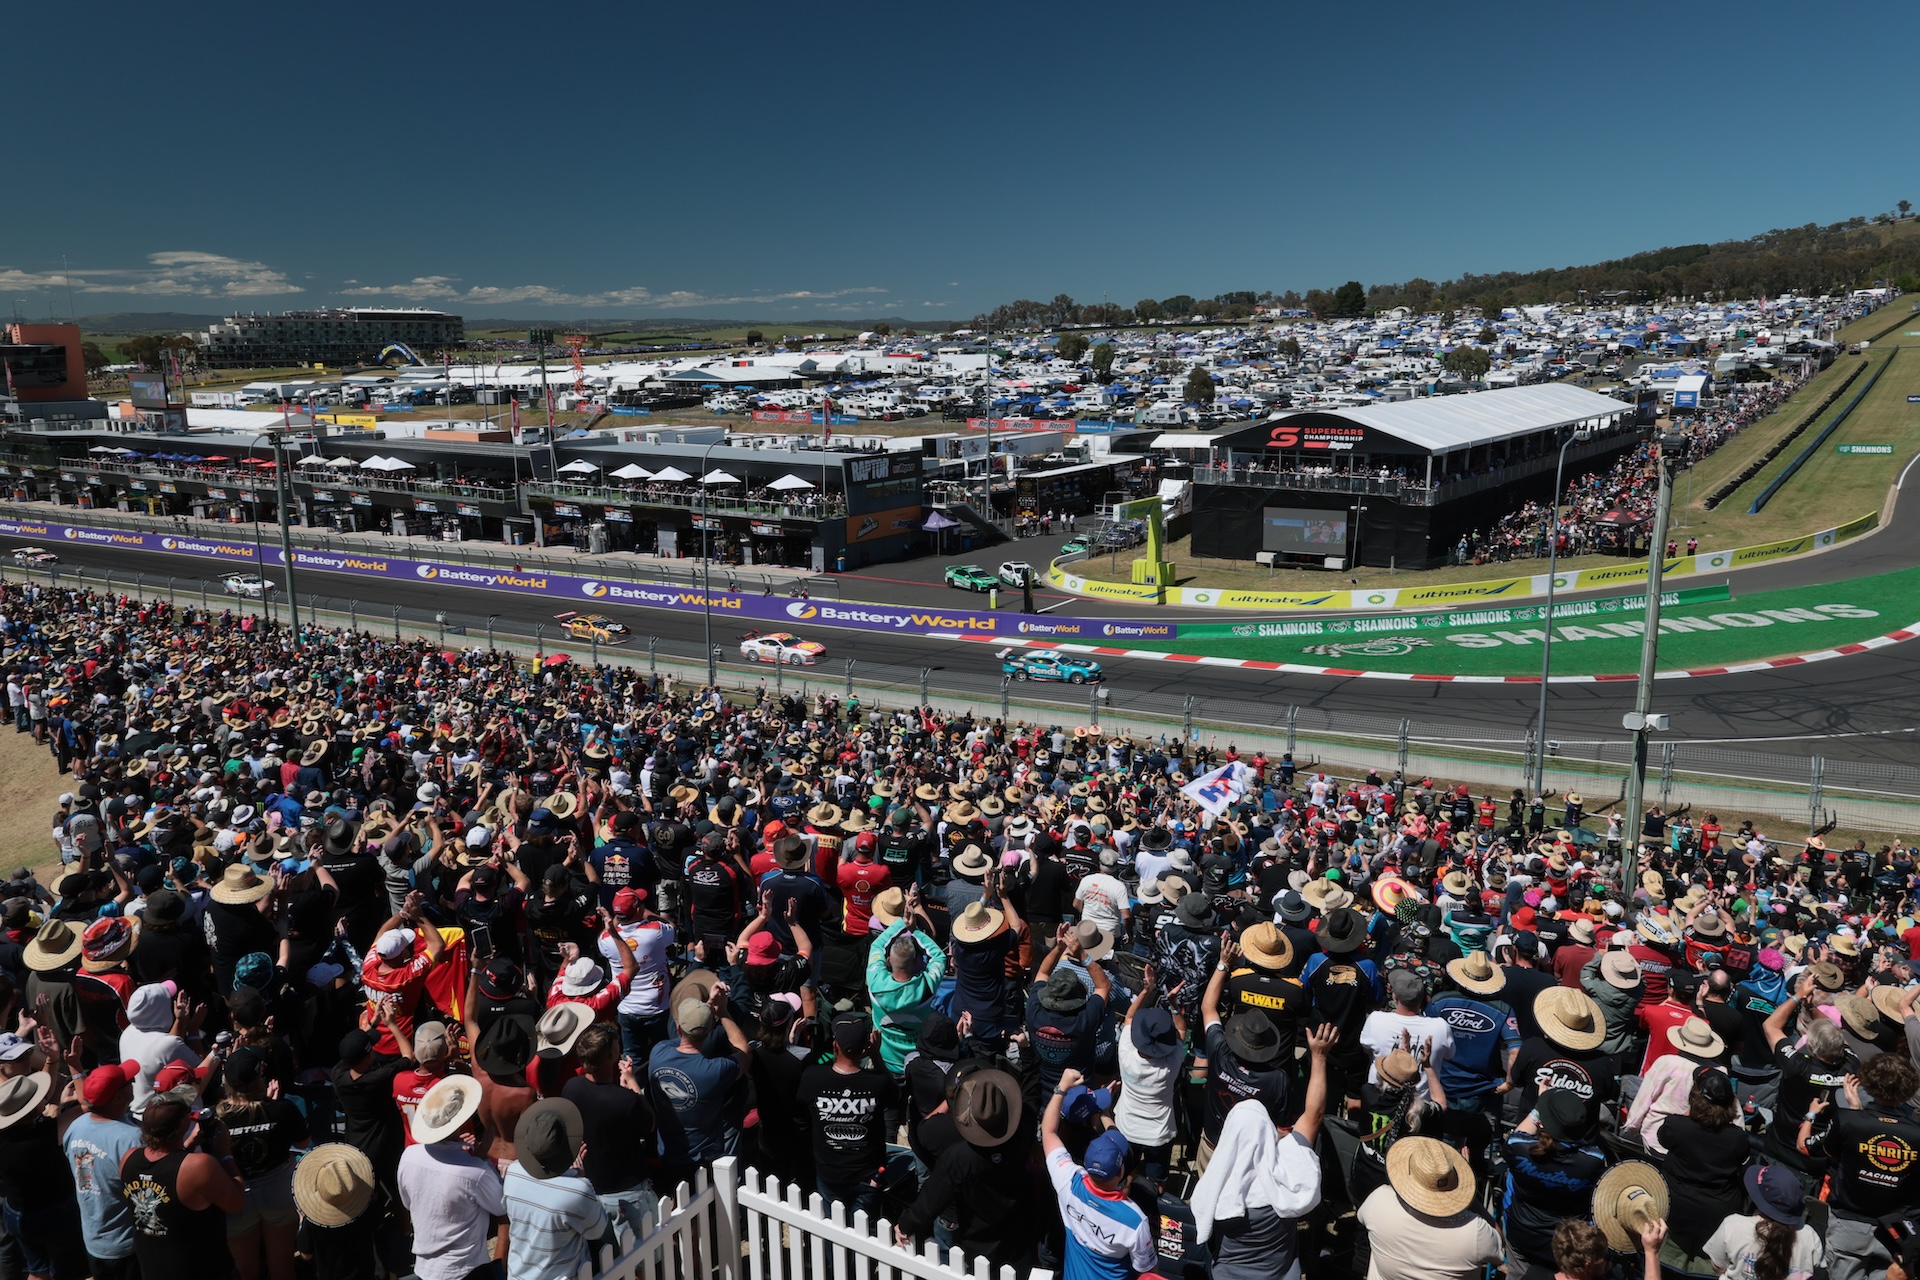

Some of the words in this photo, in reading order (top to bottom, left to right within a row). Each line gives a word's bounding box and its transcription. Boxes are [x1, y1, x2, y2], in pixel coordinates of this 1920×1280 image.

[1012, 421, 1034, 430] Repco
[1049, 421, 1071, 431] Repco
[1304, 427, 1364, 436] SUPERCARS
[1328, 440, 1354, 450] Repco
[1851, 445, 1892, 454] SHANNONS
[850, 457, 889, 482] RAPTOR
[78, 530, 144, 546] BatteryWorld
[177, 541, 254, 558] BatteryWorld
[1738, 545, 1790, 560] ultimate
[297, 554, 388, 572] BatteryWorld
[439, 568, 547, 590] BatteryWorld
[609, 586, 742, 611] BatteryWorld
[1088, 585, 1143, 598] ultimate
[1230, 594, 1303, 605] ultimate
[1413, 586, 1488, 600] ultimate
[820, 607, 997, 631] BatteryWorld
[1353, 616, 1418, 633] SHANNONS
[1445, 603, 1880, 649] SHANNONS
[1448, 609, 1511, 627] SHANNONS
[1029, 622, 1081, 635] BatteryWorld
[1114, 623, 1168, 636] BatteryWorld
[1258, 622, 1323, 637] SHANNONS
[1028, 665, 1062, 677] Bendix
[1447, 1011, 1483, 1032] Ford
[1218, 1071, 1261, 1097] BATHURST
[1534, 1067, 1594, 1100] Eldora
[816, 1097, 876, 1115] DXXN
[819, 1111, 857, 1123] Flannel
[1859, 1142, 1918, 1162] PENRITE
[1859, 1169, 1899, 1182] RACING
[142, 1181, 171, 1204] HUEYS
[1066, 1204, 1116, 1245] GRM
